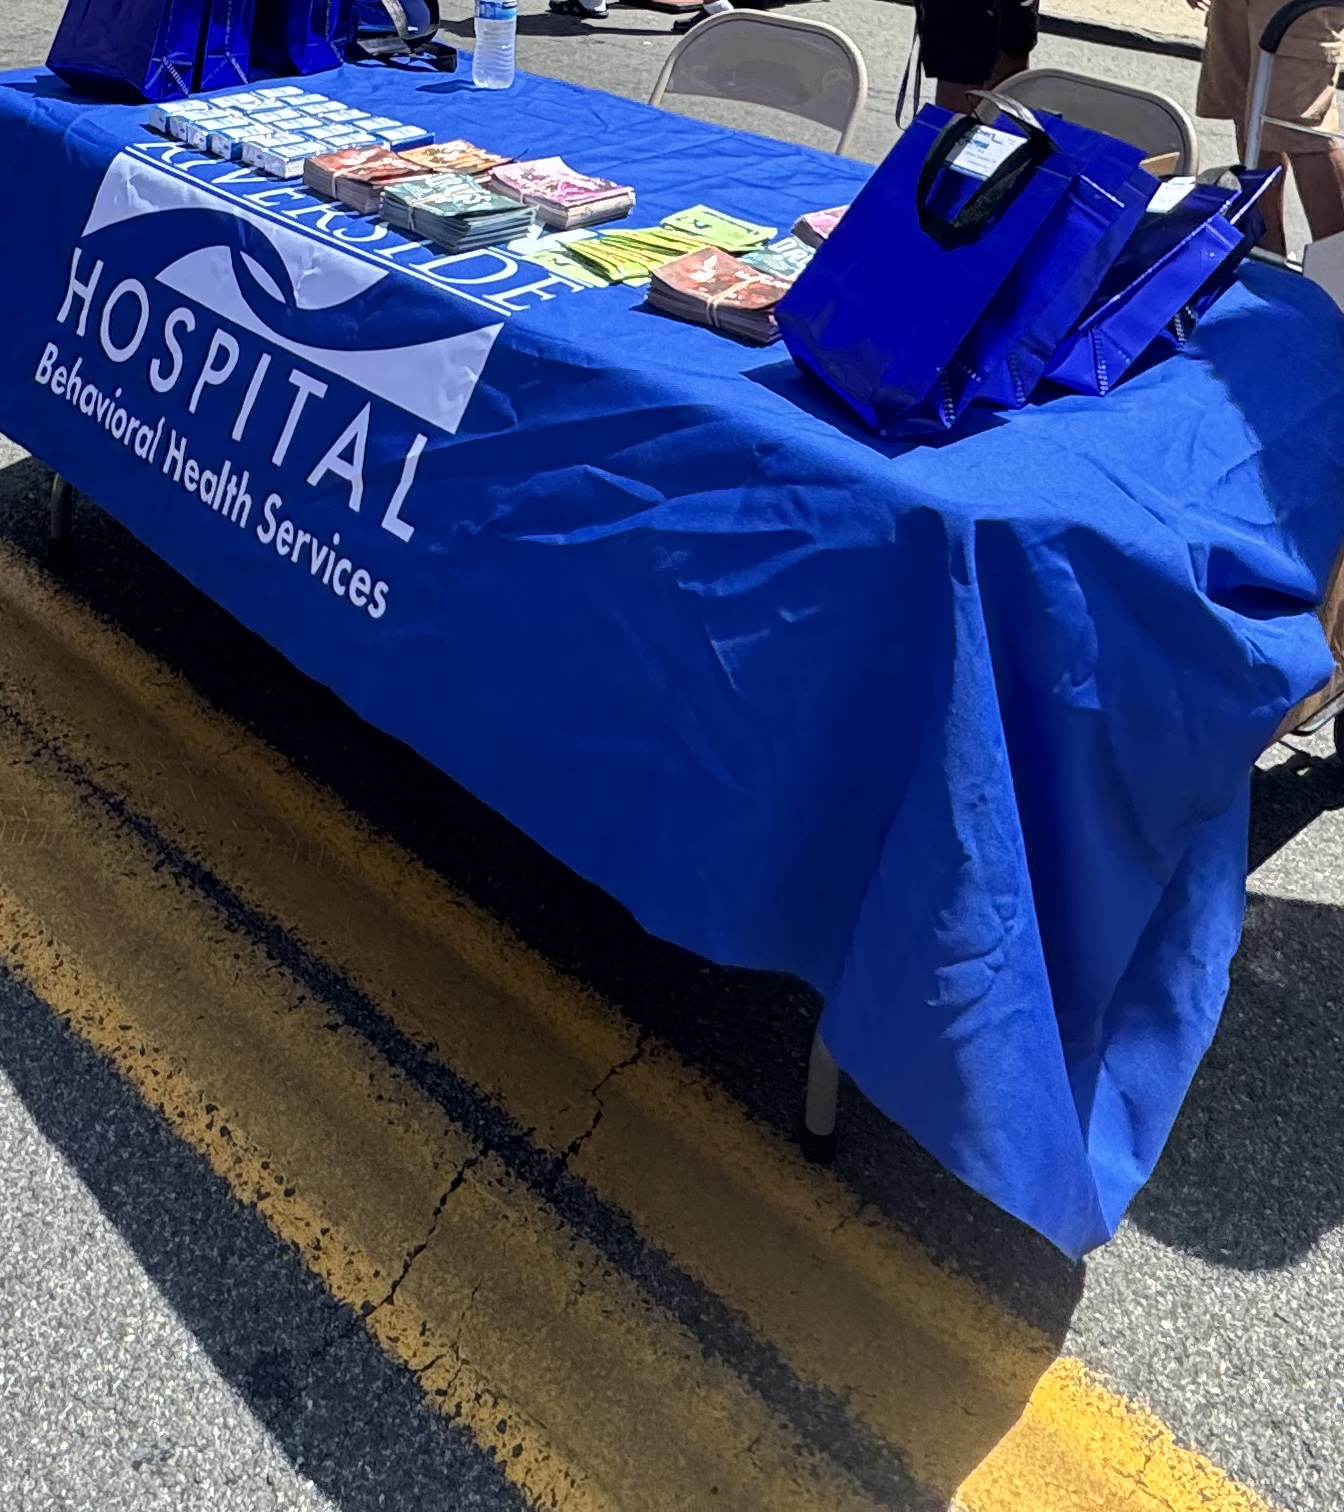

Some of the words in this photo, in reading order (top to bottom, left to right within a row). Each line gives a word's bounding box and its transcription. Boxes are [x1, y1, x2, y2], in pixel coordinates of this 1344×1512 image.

[34, 341, 164, 464] Behavioral
[162, 428, 253, 528] Health
[256, 492, 390, 619] Services
[57, 246, 429, 543] HOSPITAL
